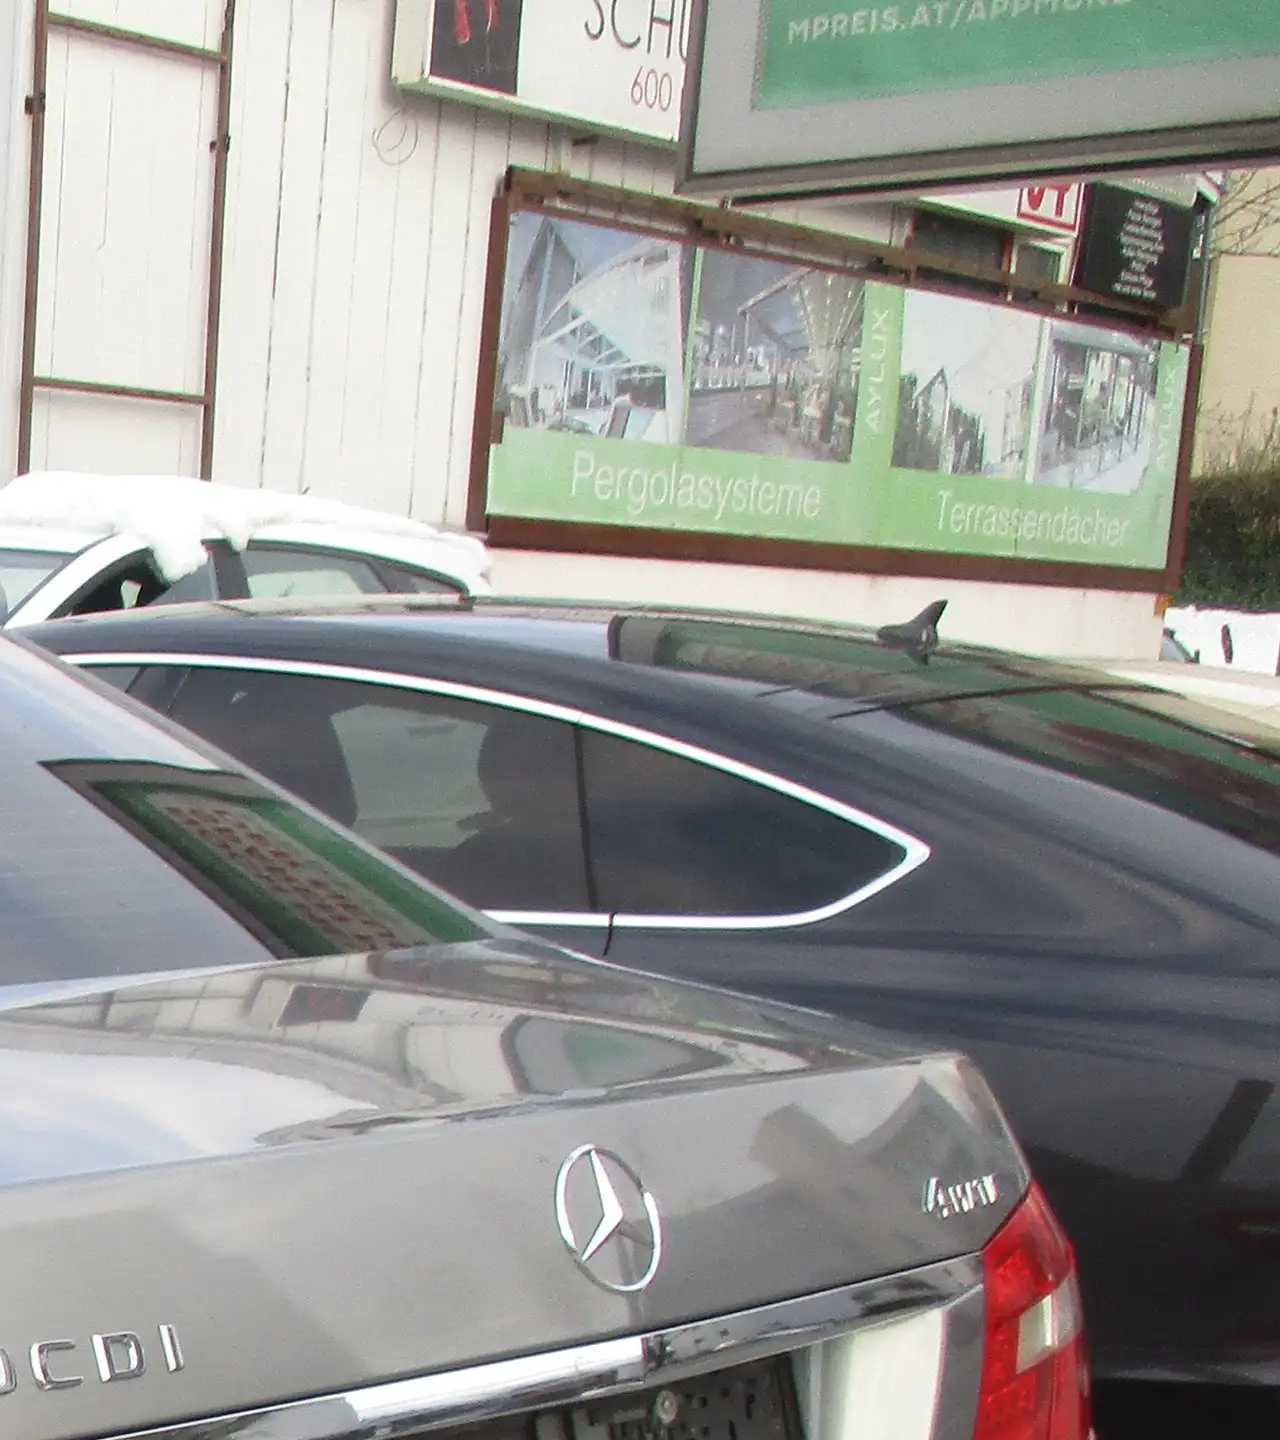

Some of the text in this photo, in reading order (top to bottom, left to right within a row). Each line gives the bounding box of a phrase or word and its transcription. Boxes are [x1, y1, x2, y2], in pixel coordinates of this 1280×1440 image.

[631, 65, 672, 112] 600
[572, 451, 821, 525] Pergolasysteme
[936, 488, 1129, 548] Terrassendächer
